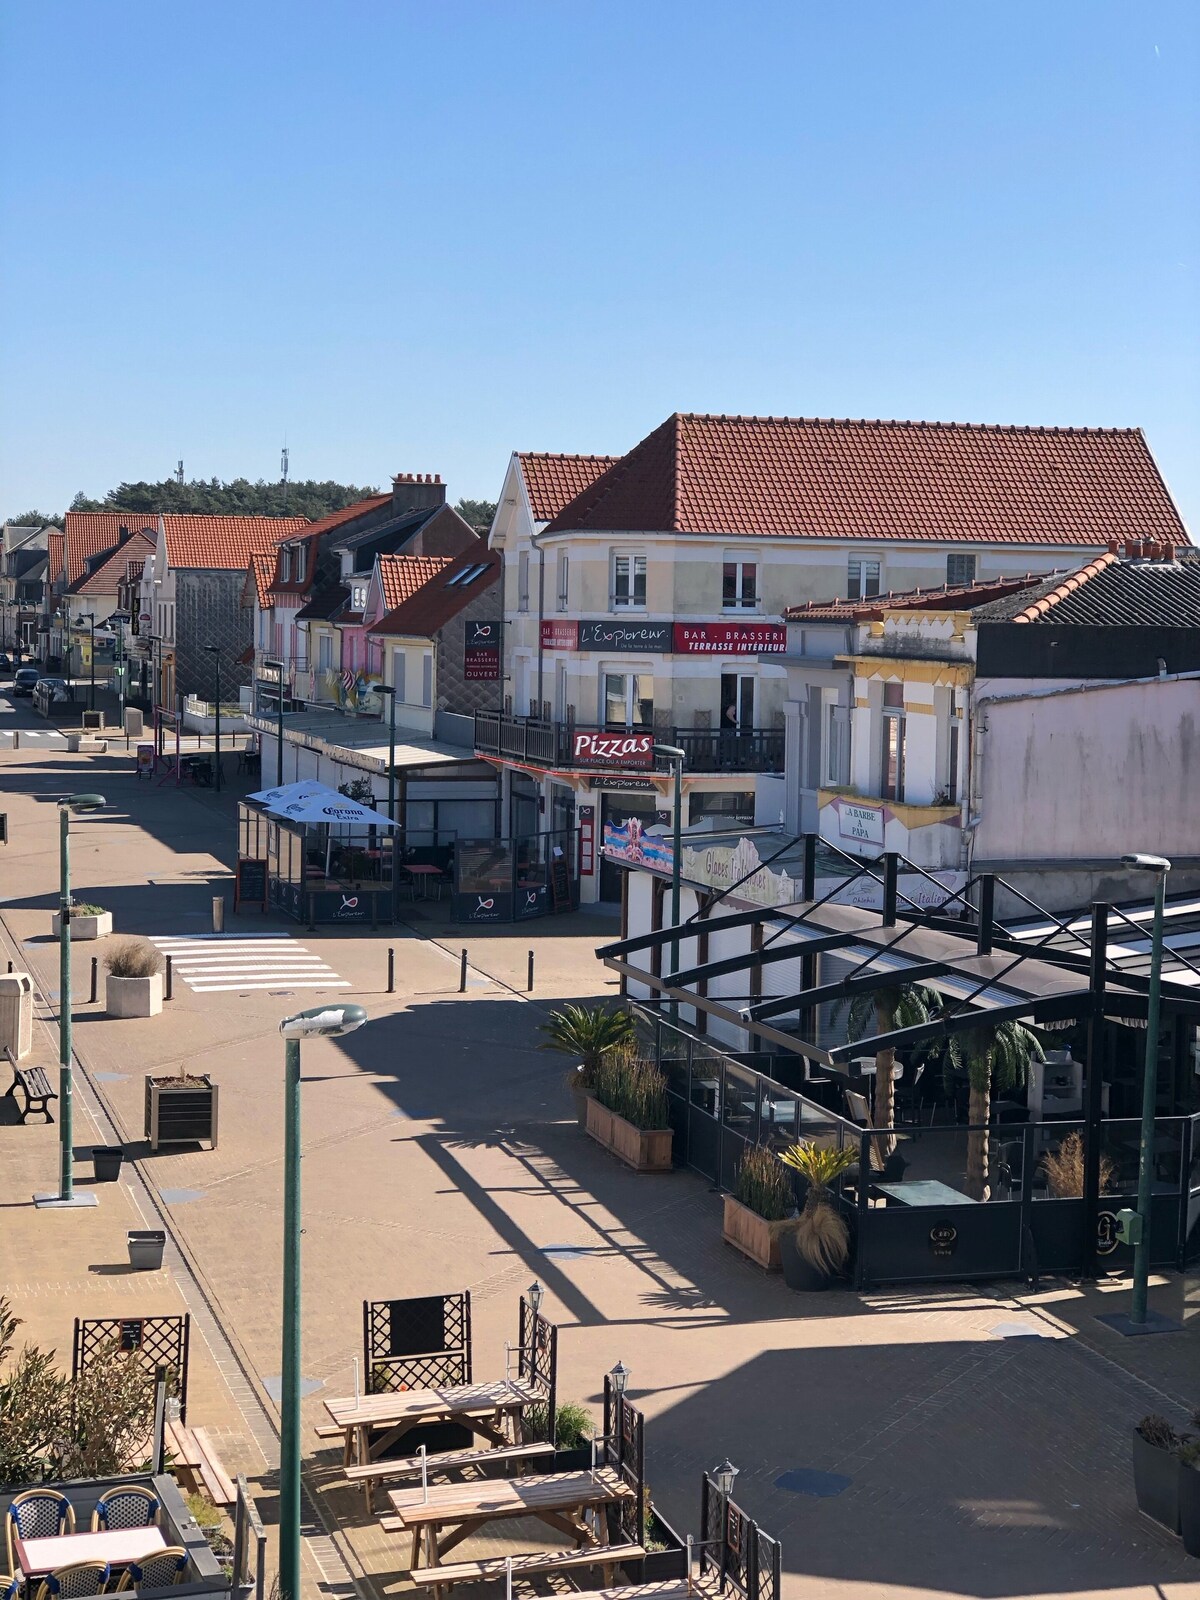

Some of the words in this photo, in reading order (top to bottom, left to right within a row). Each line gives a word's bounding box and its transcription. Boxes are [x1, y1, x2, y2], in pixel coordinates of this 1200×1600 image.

[582, 624, 665, 646] L'Exploreur
[684, 631, 706, 639] BAR
[726, 631, 783, 640] BRASSERI
[688, 642, 733, 651] TERRASSE
[737, 641, 788, 652] INTÉRIEUR
[575, 735, 651, 758] Pizzas
[322, 806, 364, 817] Corona
[337, 813, 360, 821] Extra
[853, 809, 876, 821] BARBE
[857, 819, 863, 828] A
[852, 826, 870, 839] PAPA
[705, 851, 729, 878] Glaces
